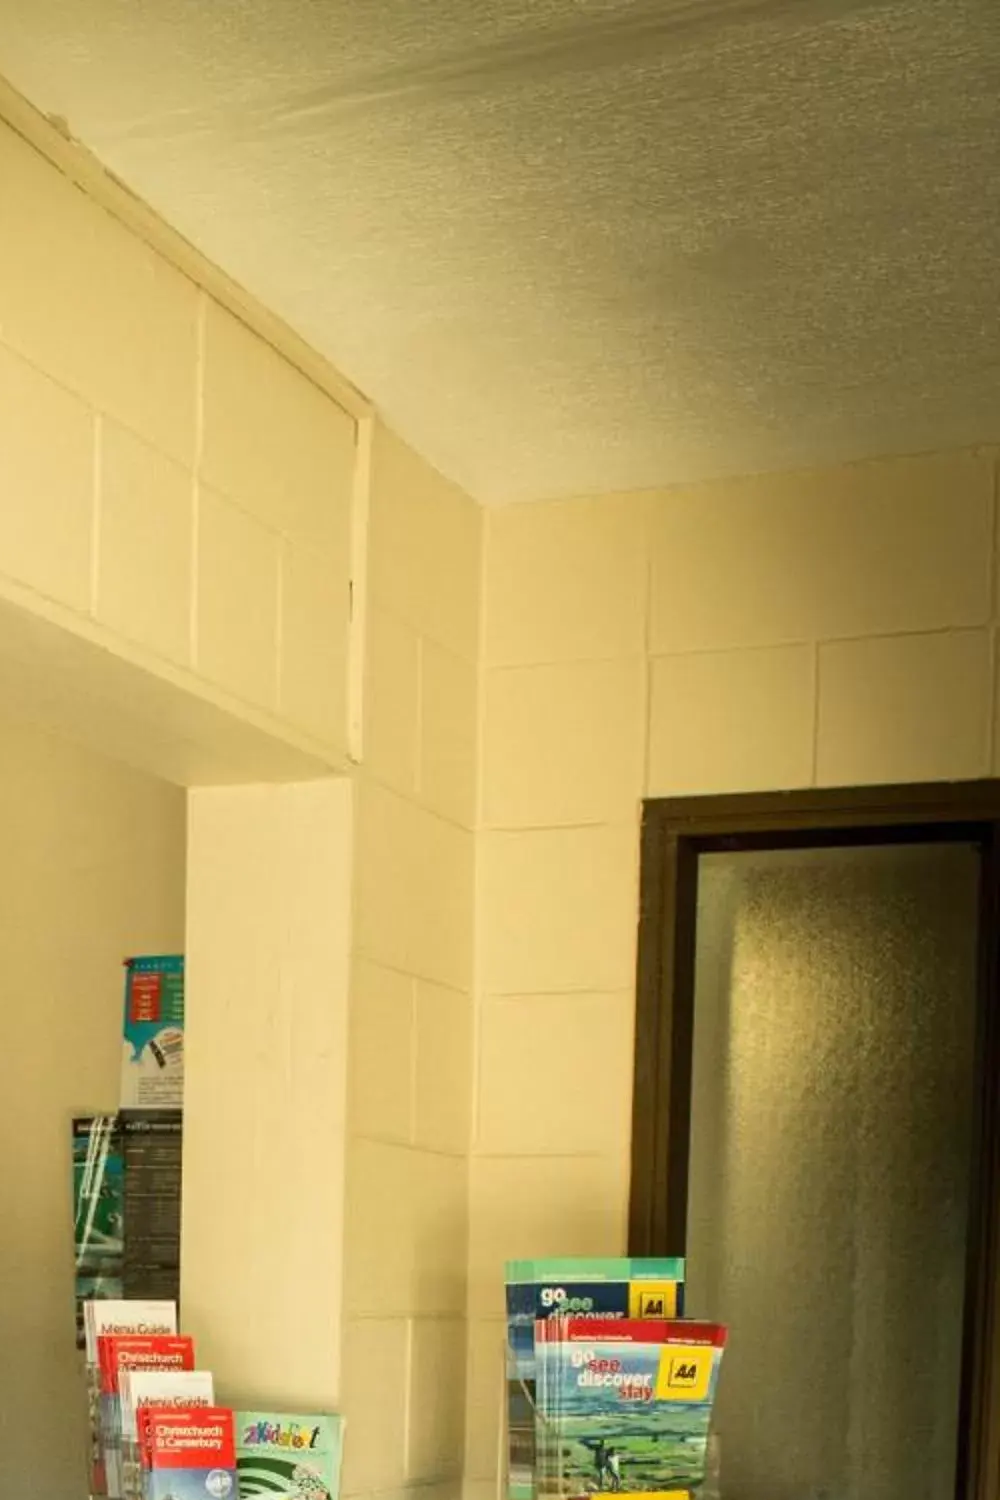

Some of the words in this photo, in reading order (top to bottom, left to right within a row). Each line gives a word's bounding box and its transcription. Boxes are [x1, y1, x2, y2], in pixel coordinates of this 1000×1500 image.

[541, 1288, 567, 1307] go
[561, 1297, 593, 1311] see
[645, 1299, 664, 1314] AA
[102, 1323, 135, 1335] Menu
[137, 1323, 172, 1335] Guide
[118, 1352, 183, 1364] Christchurch
[571, 1350, 595, 1367] go
[588, 1359, 621, 1373] see
[674, 1363, 697, 1380] AA
[577, 1370, 653, 1387] discover
[619, 1384, 653, 1401] stay
[137, 1396, 172, 1408] Menu
[173, 1396, 209, 1408] Guide
[155, 1425, 223, 1437] Christchurch
[166, 1438, 222, 1449] Canterbury
